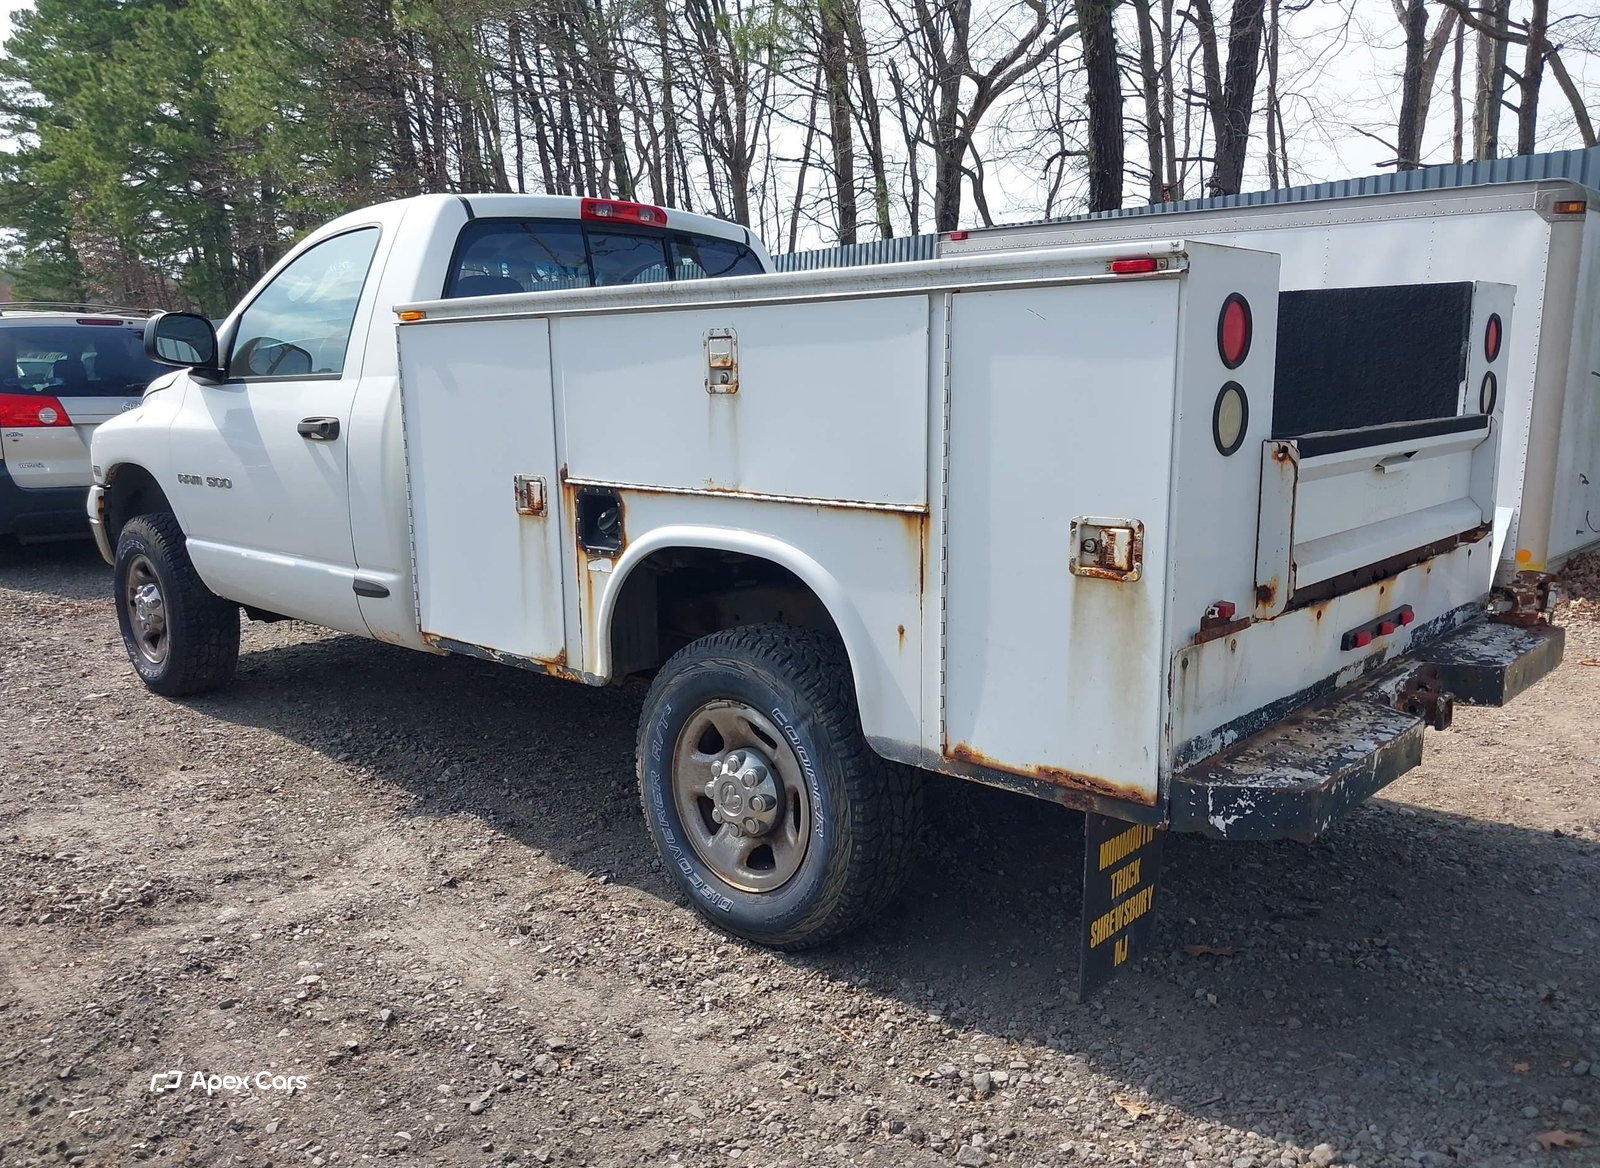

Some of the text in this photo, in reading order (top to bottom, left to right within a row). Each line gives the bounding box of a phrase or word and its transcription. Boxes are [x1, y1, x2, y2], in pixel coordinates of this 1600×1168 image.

[177, 473, 233, 489] RAM 500
[771, 707, 825, 838] COOPER
[651, 771, 734, 912] DISCOVERER
[1110, 857, 1141, 900] TRUCK
[1090, 883, 1155, 949] SHREWSBURY
[1113, 934, 1129, 967] NJ
